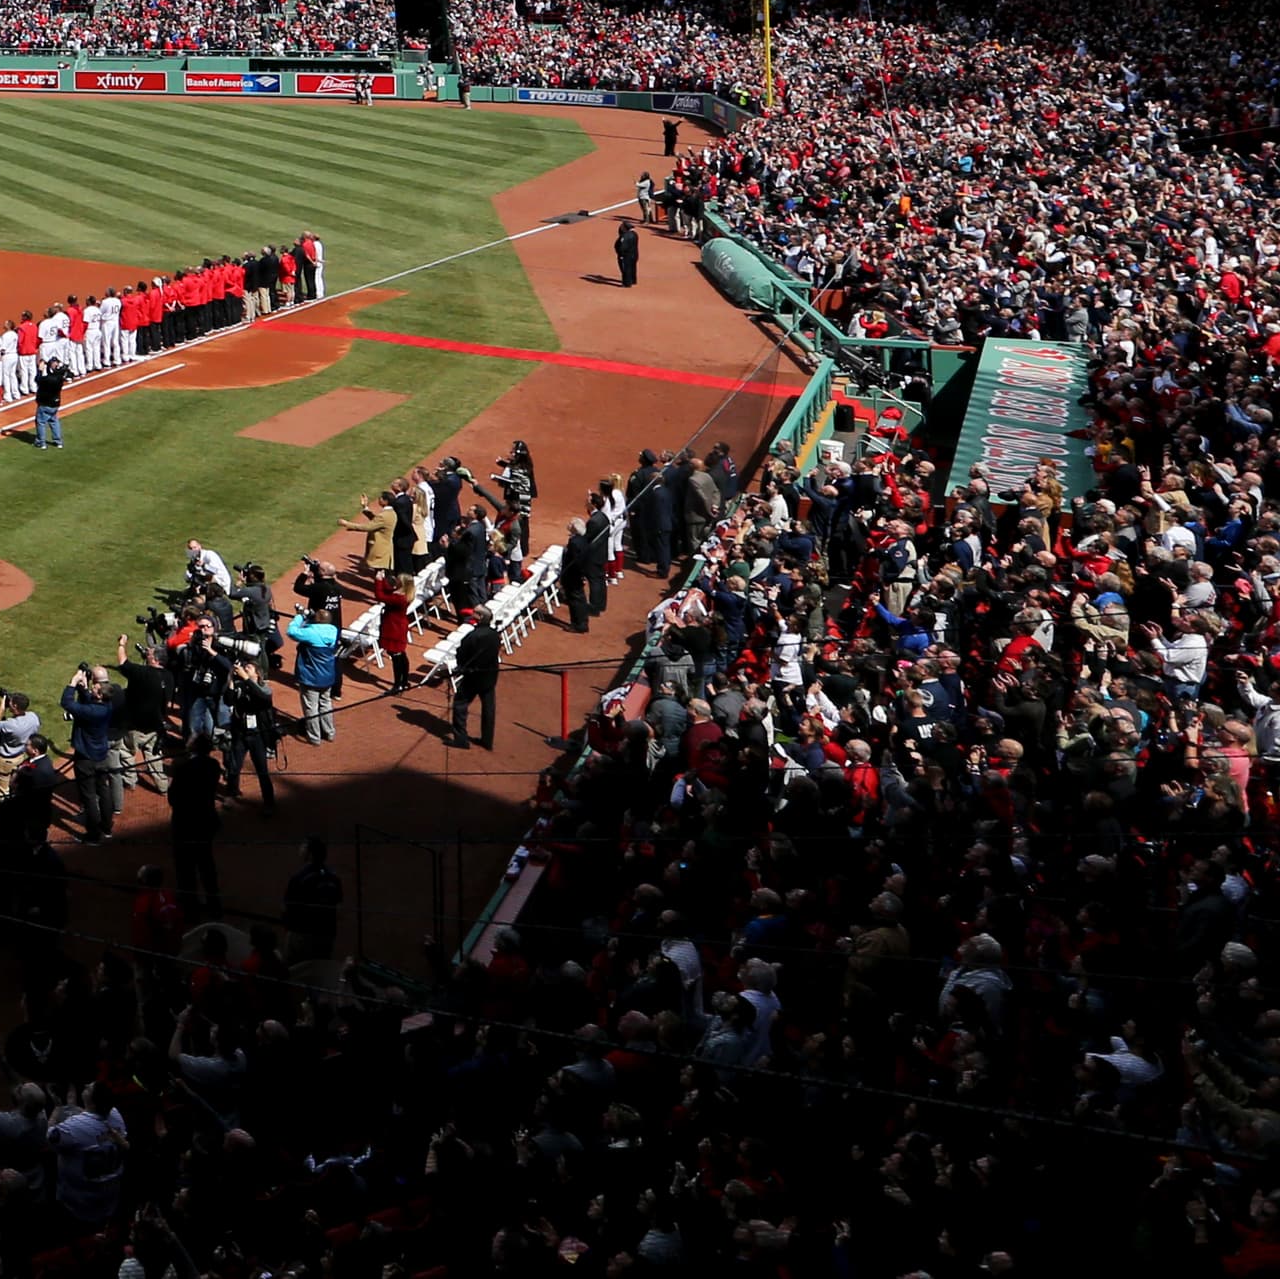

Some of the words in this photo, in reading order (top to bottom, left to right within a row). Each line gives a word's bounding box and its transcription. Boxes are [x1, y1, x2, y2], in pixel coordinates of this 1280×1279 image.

[22, 74, 57, 85] JOE'S
[96, 73, 144, 89] xfinity
[529, 90, 565, 101] TOYO
[567, 92, 604, 104] TIRES
[996, 356, 1075, 394] SOX
[989, 388, 1070, 428] RED
